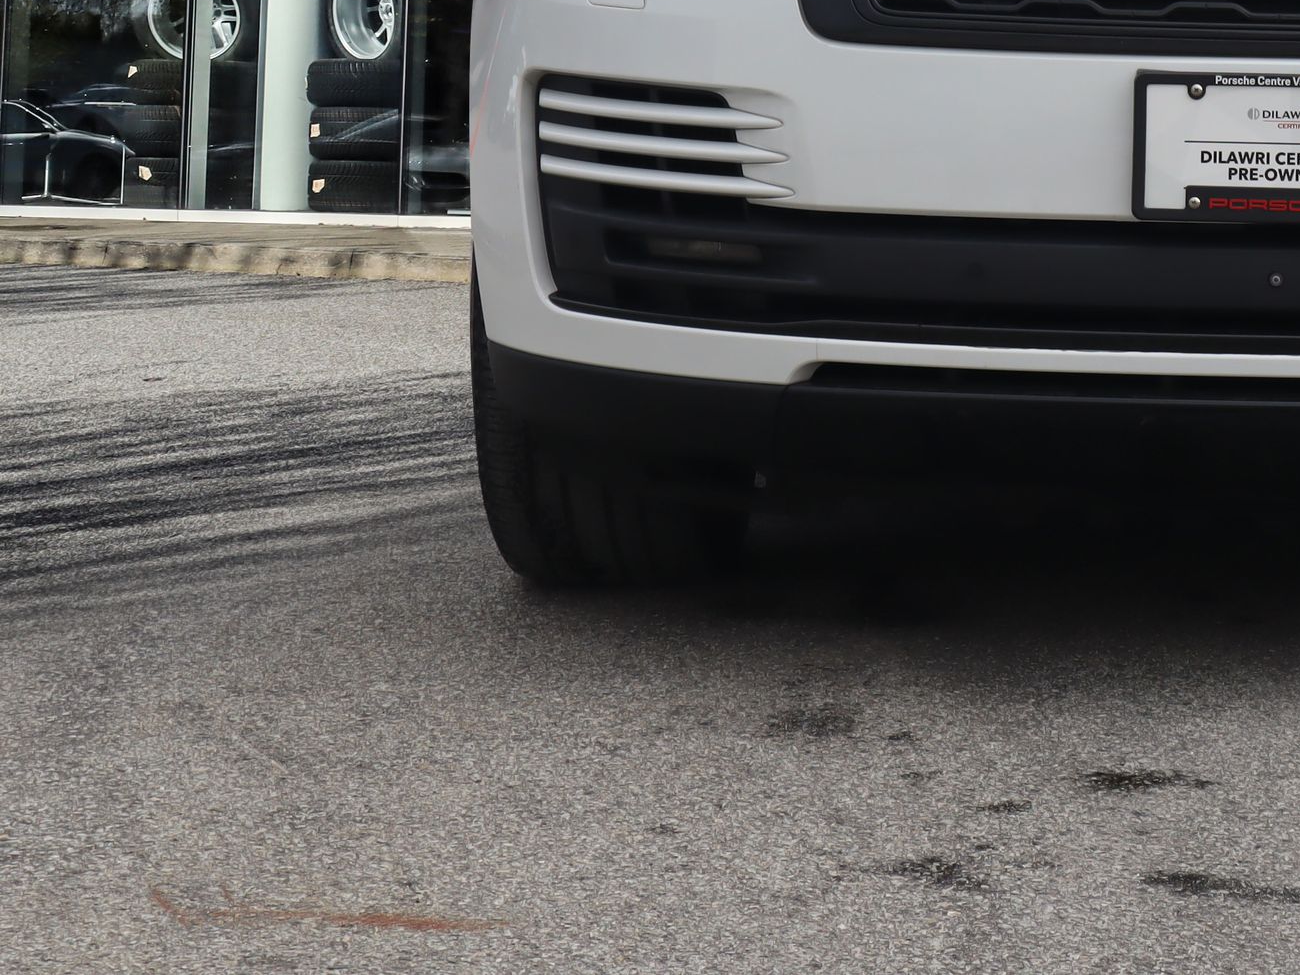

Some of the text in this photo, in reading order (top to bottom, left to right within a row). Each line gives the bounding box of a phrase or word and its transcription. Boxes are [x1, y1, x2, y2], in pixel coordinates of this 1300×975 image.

[1215, 75, 1256, 86] Porsche
[1257, 76, 1292, 87] Centre
[1200, 150, 1270, 165] DILAWRI
